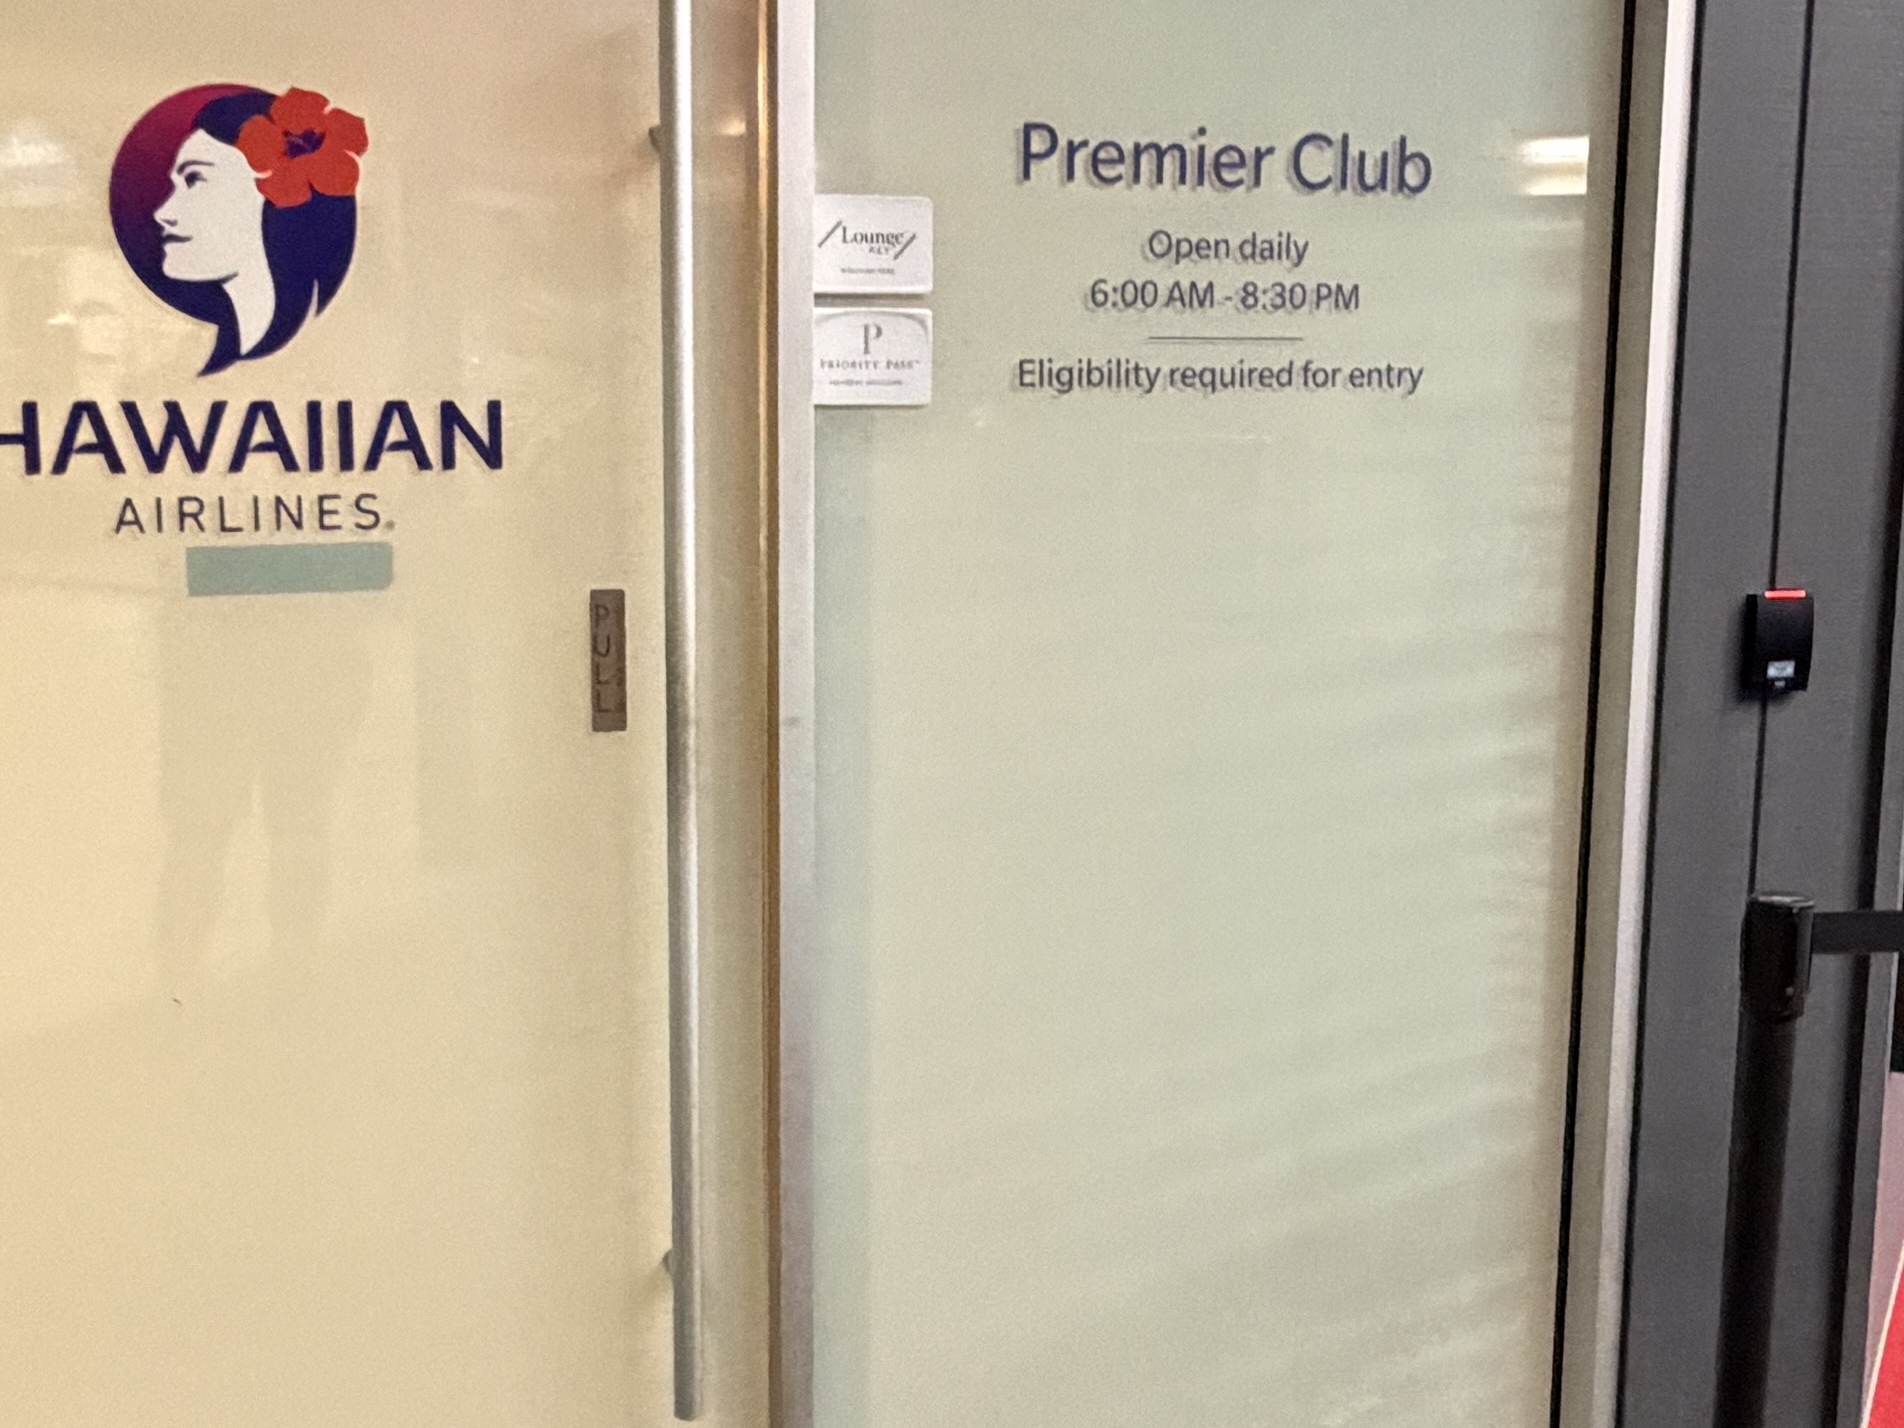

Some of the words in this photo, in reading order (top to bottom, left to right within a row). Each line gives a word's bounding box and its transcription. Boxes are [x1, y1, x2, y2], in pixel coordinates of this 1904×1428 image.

[1021, 121, 1276, 189] Premier
[1292, 131, 1433, 195] Club
[841, 225, 906, 247] Lounge
[1147, 229, 1231, 265] Open
[1237, 231, 1310, 268] daily
[1089, 278, 1159, 308] 6:00
[1164, 280, 1215, 310] AM
[1239, 281, 1308, 311] 8:30
[1314, 282, 1361, 311] PM
[1017, 357, 1161, 395] Eligibility
[1169, 359, 1294, 395] required
[1301, 360, 1344, 389] for
[1348, 361, 1425, 395] entry
[114, 493, 382, 535] AIRLINES
